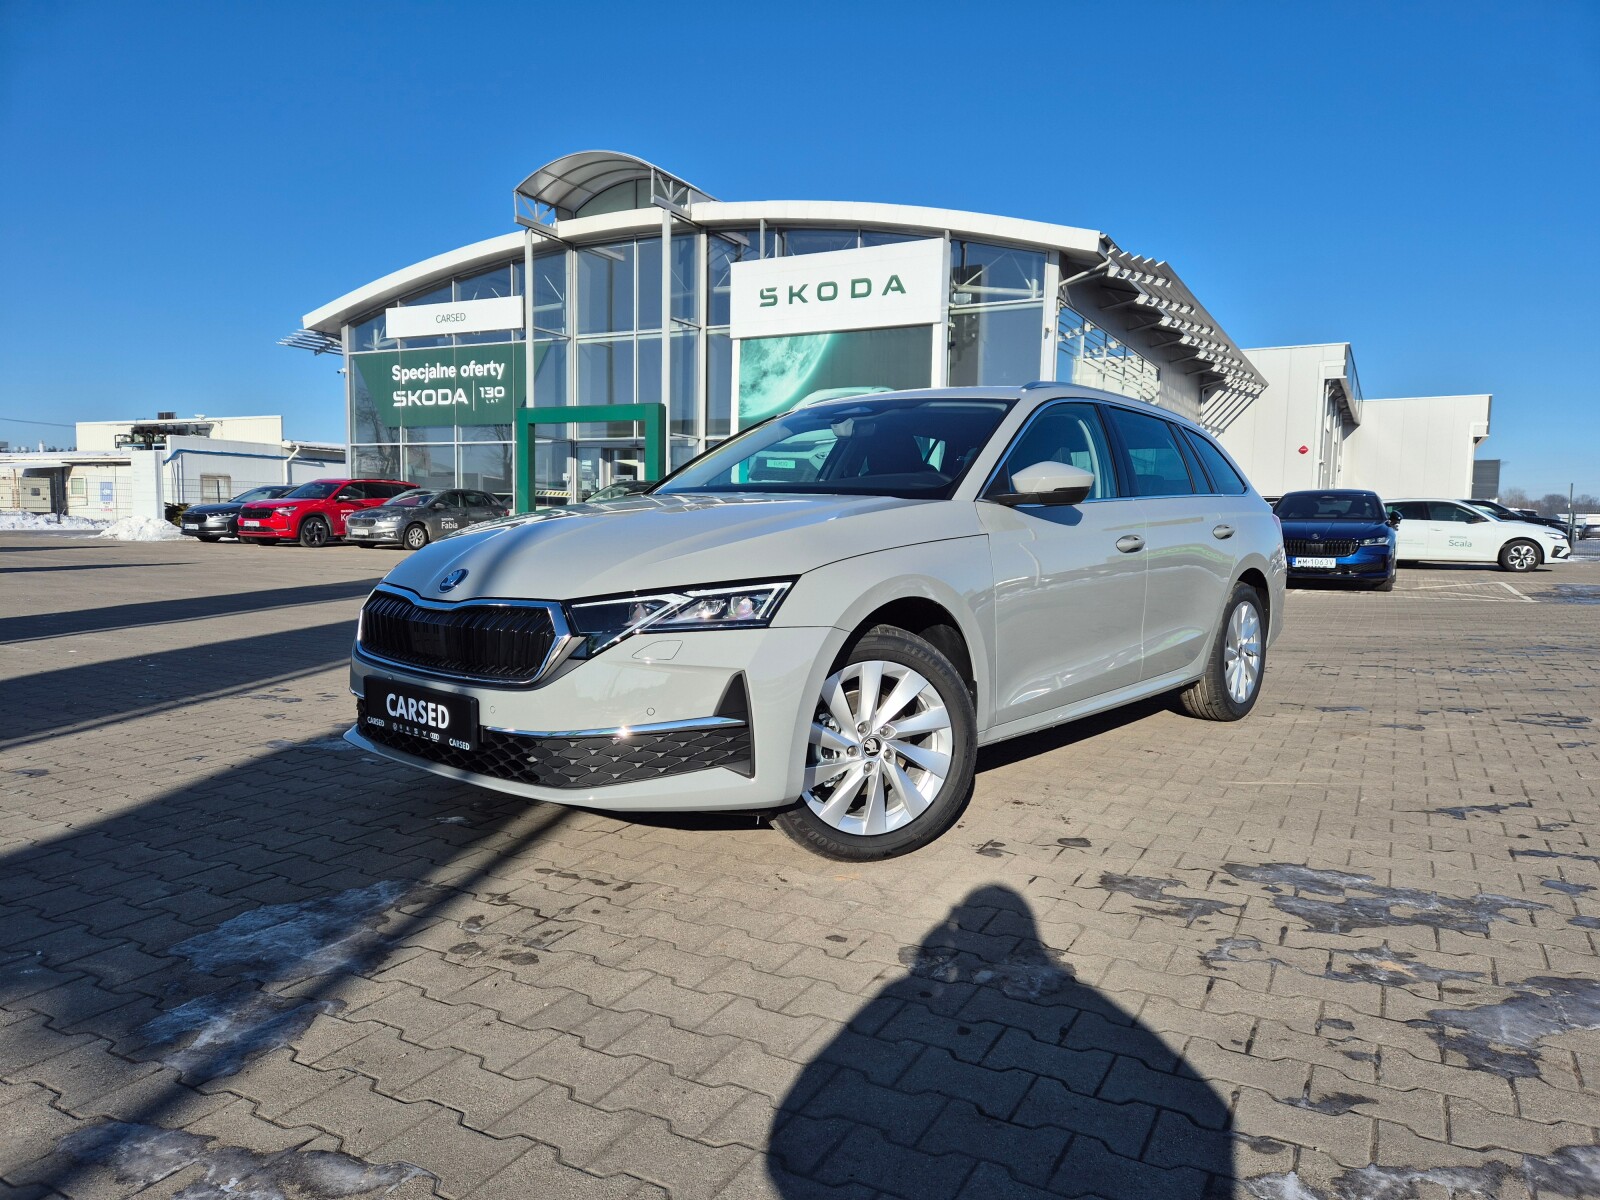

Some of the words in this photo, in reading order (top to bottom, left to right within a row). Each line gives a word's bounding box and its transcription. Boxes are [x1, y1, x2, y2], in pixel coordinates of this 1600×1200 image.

[435, 312, 467, 324] CARSED
[391, 362, 457, 385] Specjalne
[459, 360, 505, 380] oferty
[479, 386, 505, 398] 130
[441, 521, 459, 530] Fabia
[1449, 539, 1473, 548] Scala
[386, 693, 450, 729] CARSED
[367, 716, 385, 727] CARSED
[448, 738, 470, 751] CARSED
